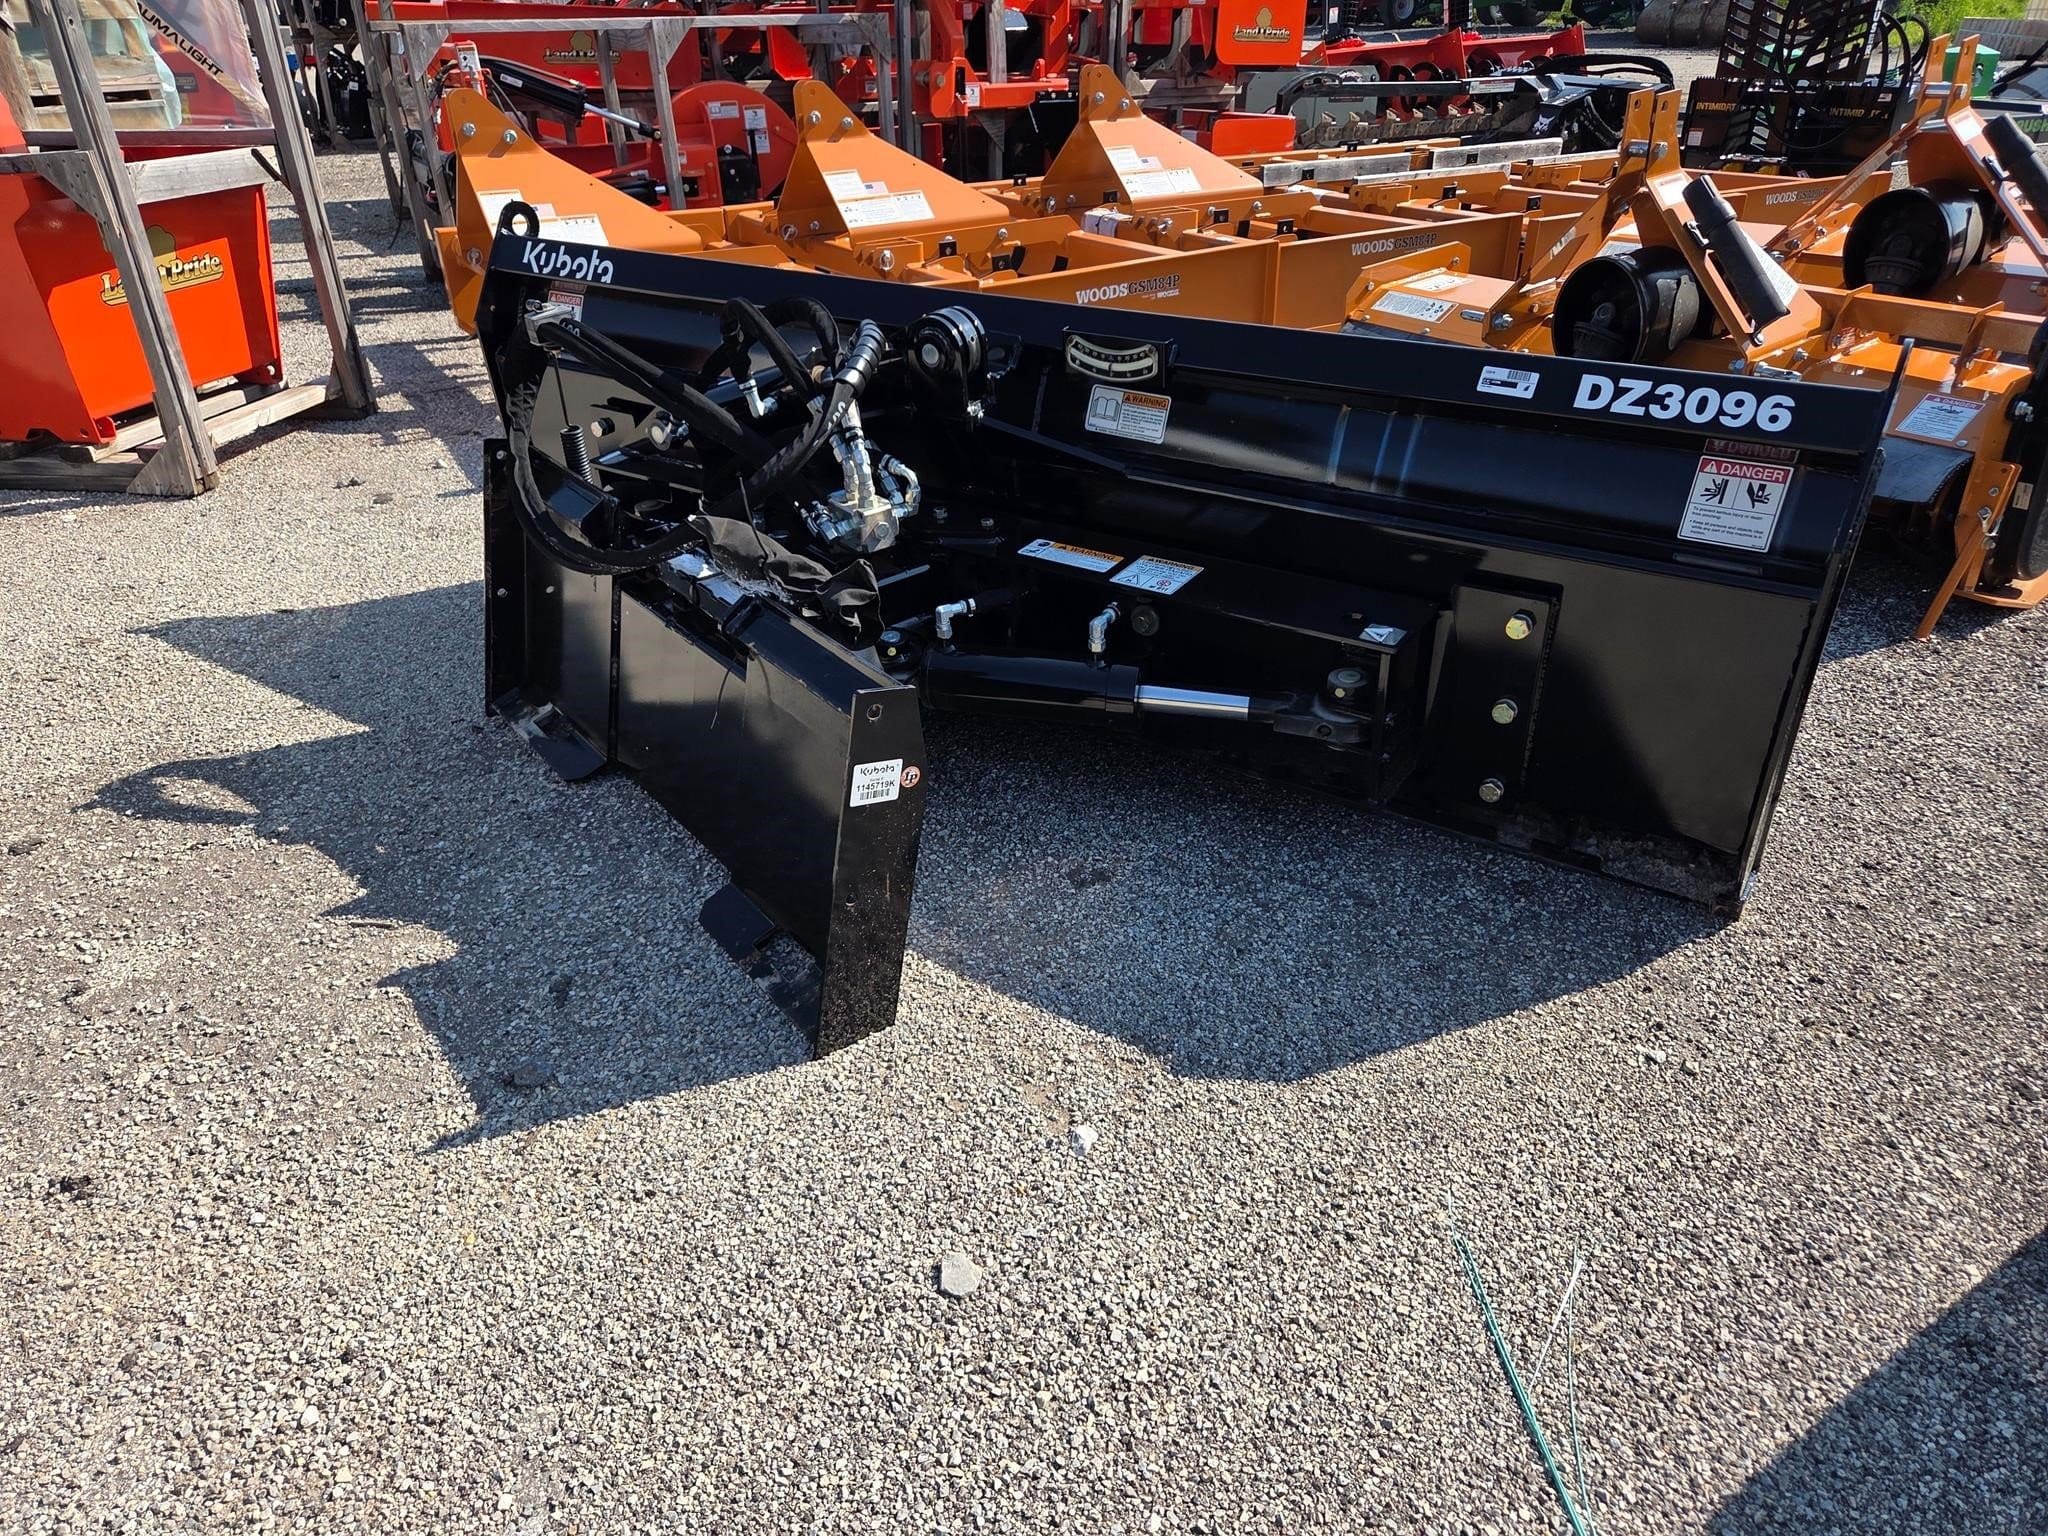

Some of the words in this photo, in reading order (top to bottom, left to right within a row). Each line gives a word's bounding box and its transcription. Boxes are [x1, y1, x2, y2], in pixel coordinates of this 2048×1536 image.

[1233, 24, 1259, 37] Land
[1265, 26, 1290, 40] Pride
[1765, 190, 1798, 205] WOODS
[1351, 238, 1394, 256] WOODS
[168, 252, 222, 283] Pride
[522, 241, 614, 284] Kubota
[1075, 283, 1128, 305] WOODS
[1127, 274, 1180, 295] GSM84P
[1131, 395, 1167, 409] WARNING
[1572, 373, 1796, 433] DZ3096
[1719, 462, 1785, 483] DANGER
[1071, 547, 1115, 561] WARNING
[860, 764, 895, 777] Kubota
[857, 780, 895, 793] 1145719K
